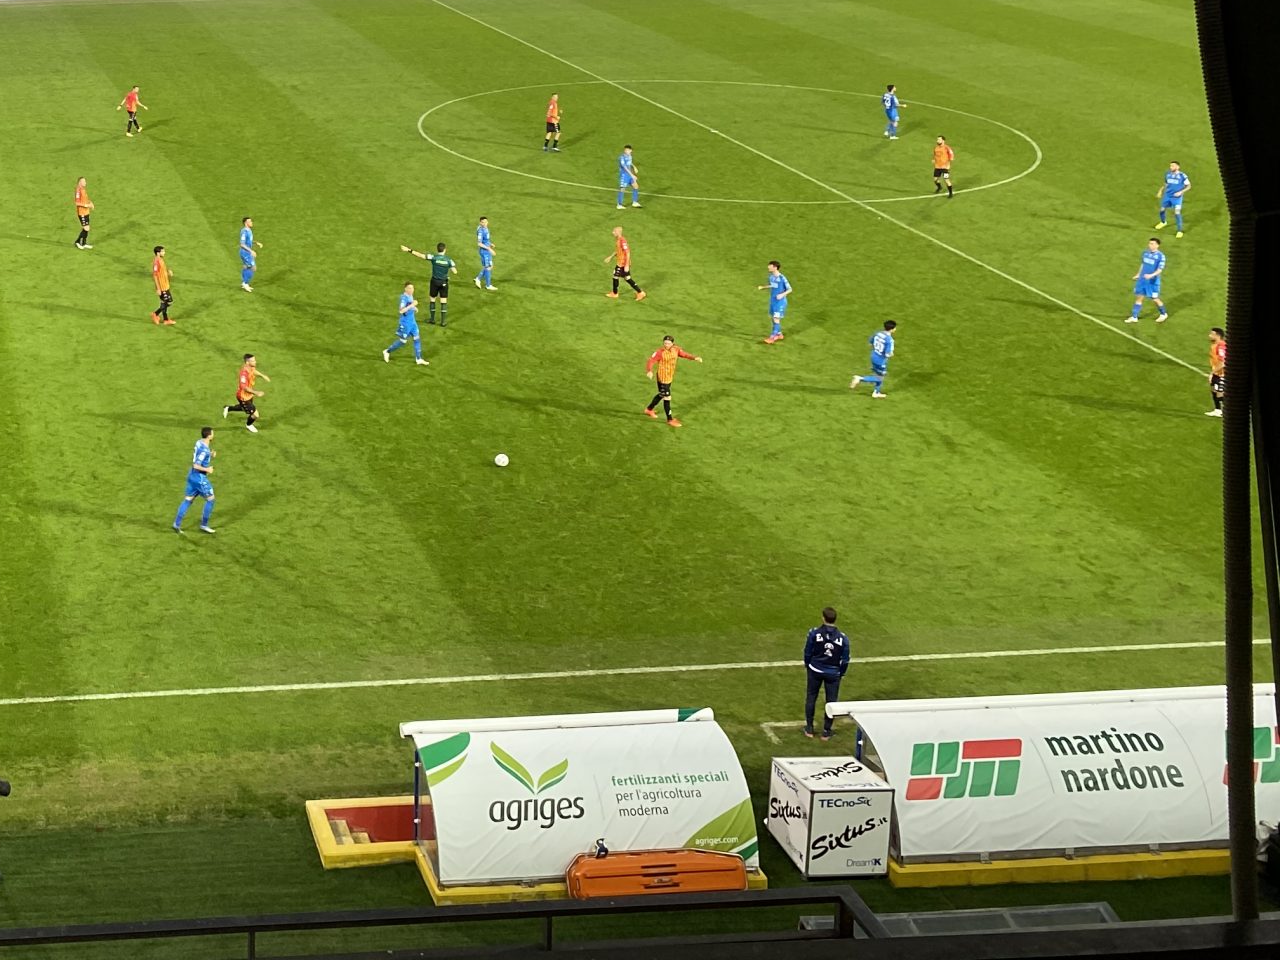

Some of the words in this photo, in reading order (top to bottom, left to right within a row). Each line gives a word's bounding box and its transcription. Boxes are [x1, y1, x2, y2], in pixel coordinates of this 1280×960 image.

[1044, 726, 1164, 756] martino
[611, 773, 682, 788] fertilizzanti
[684, 770, 730, 787] speciali
[1061, 759, 1184, 793] nardone
[616, 792, 633, 804] per
[636, 788, 702, 803] l'agricoltura
[489, 796, 585, 830] agriges
[619, 804, 670, 818] moderna
[695, 836, 739, 848] agriges.com
